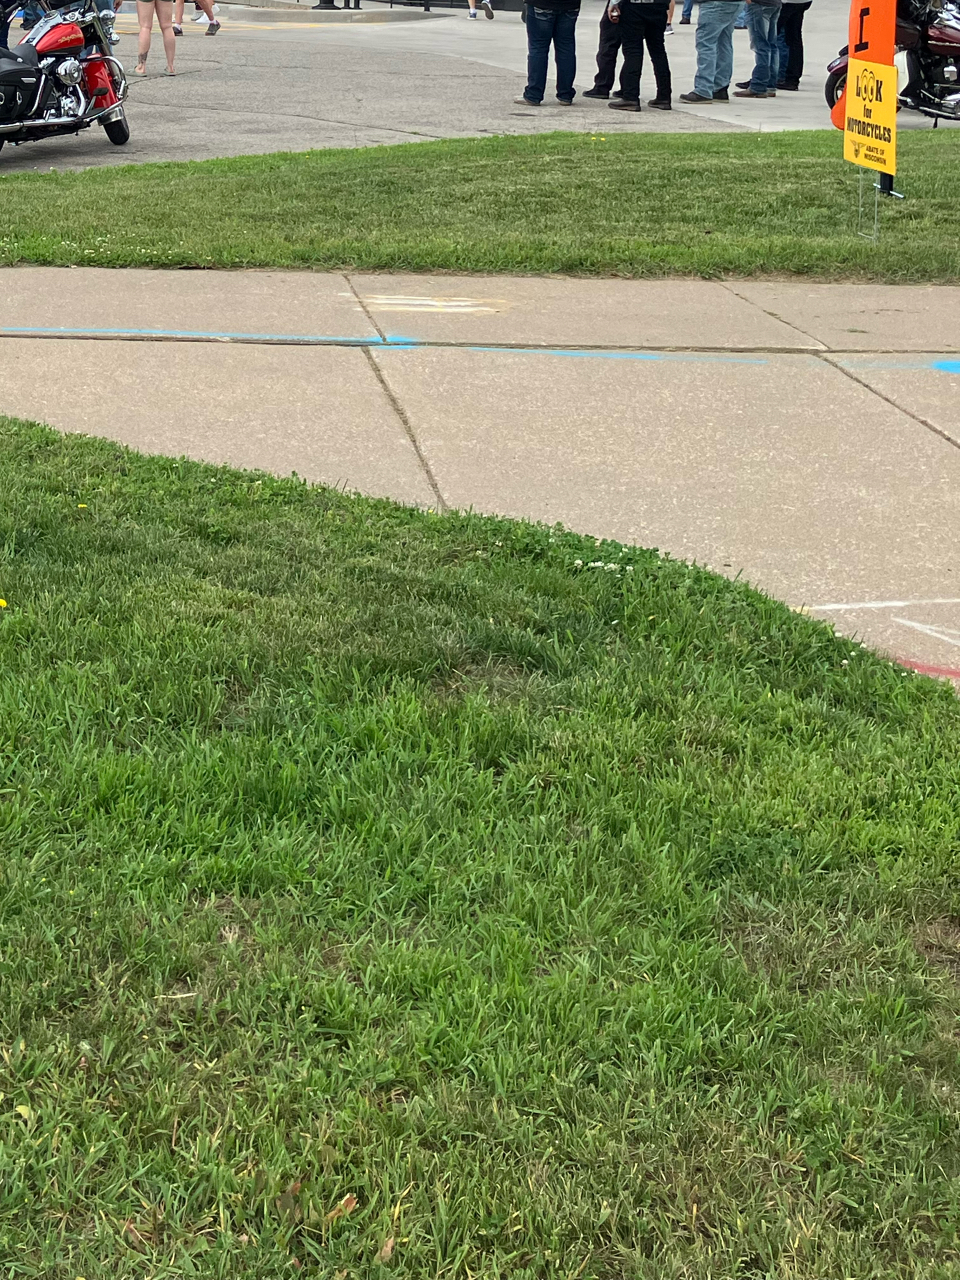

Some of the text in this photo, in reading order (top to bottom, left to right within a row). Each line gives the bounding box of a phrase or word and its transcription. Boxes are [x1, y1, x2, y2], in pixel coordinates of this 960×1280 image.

[855, 71, 883, 102] LOOK
[863, 104, 872, 119] for
[847, 117, 891, 143] MOTORCYCLES
